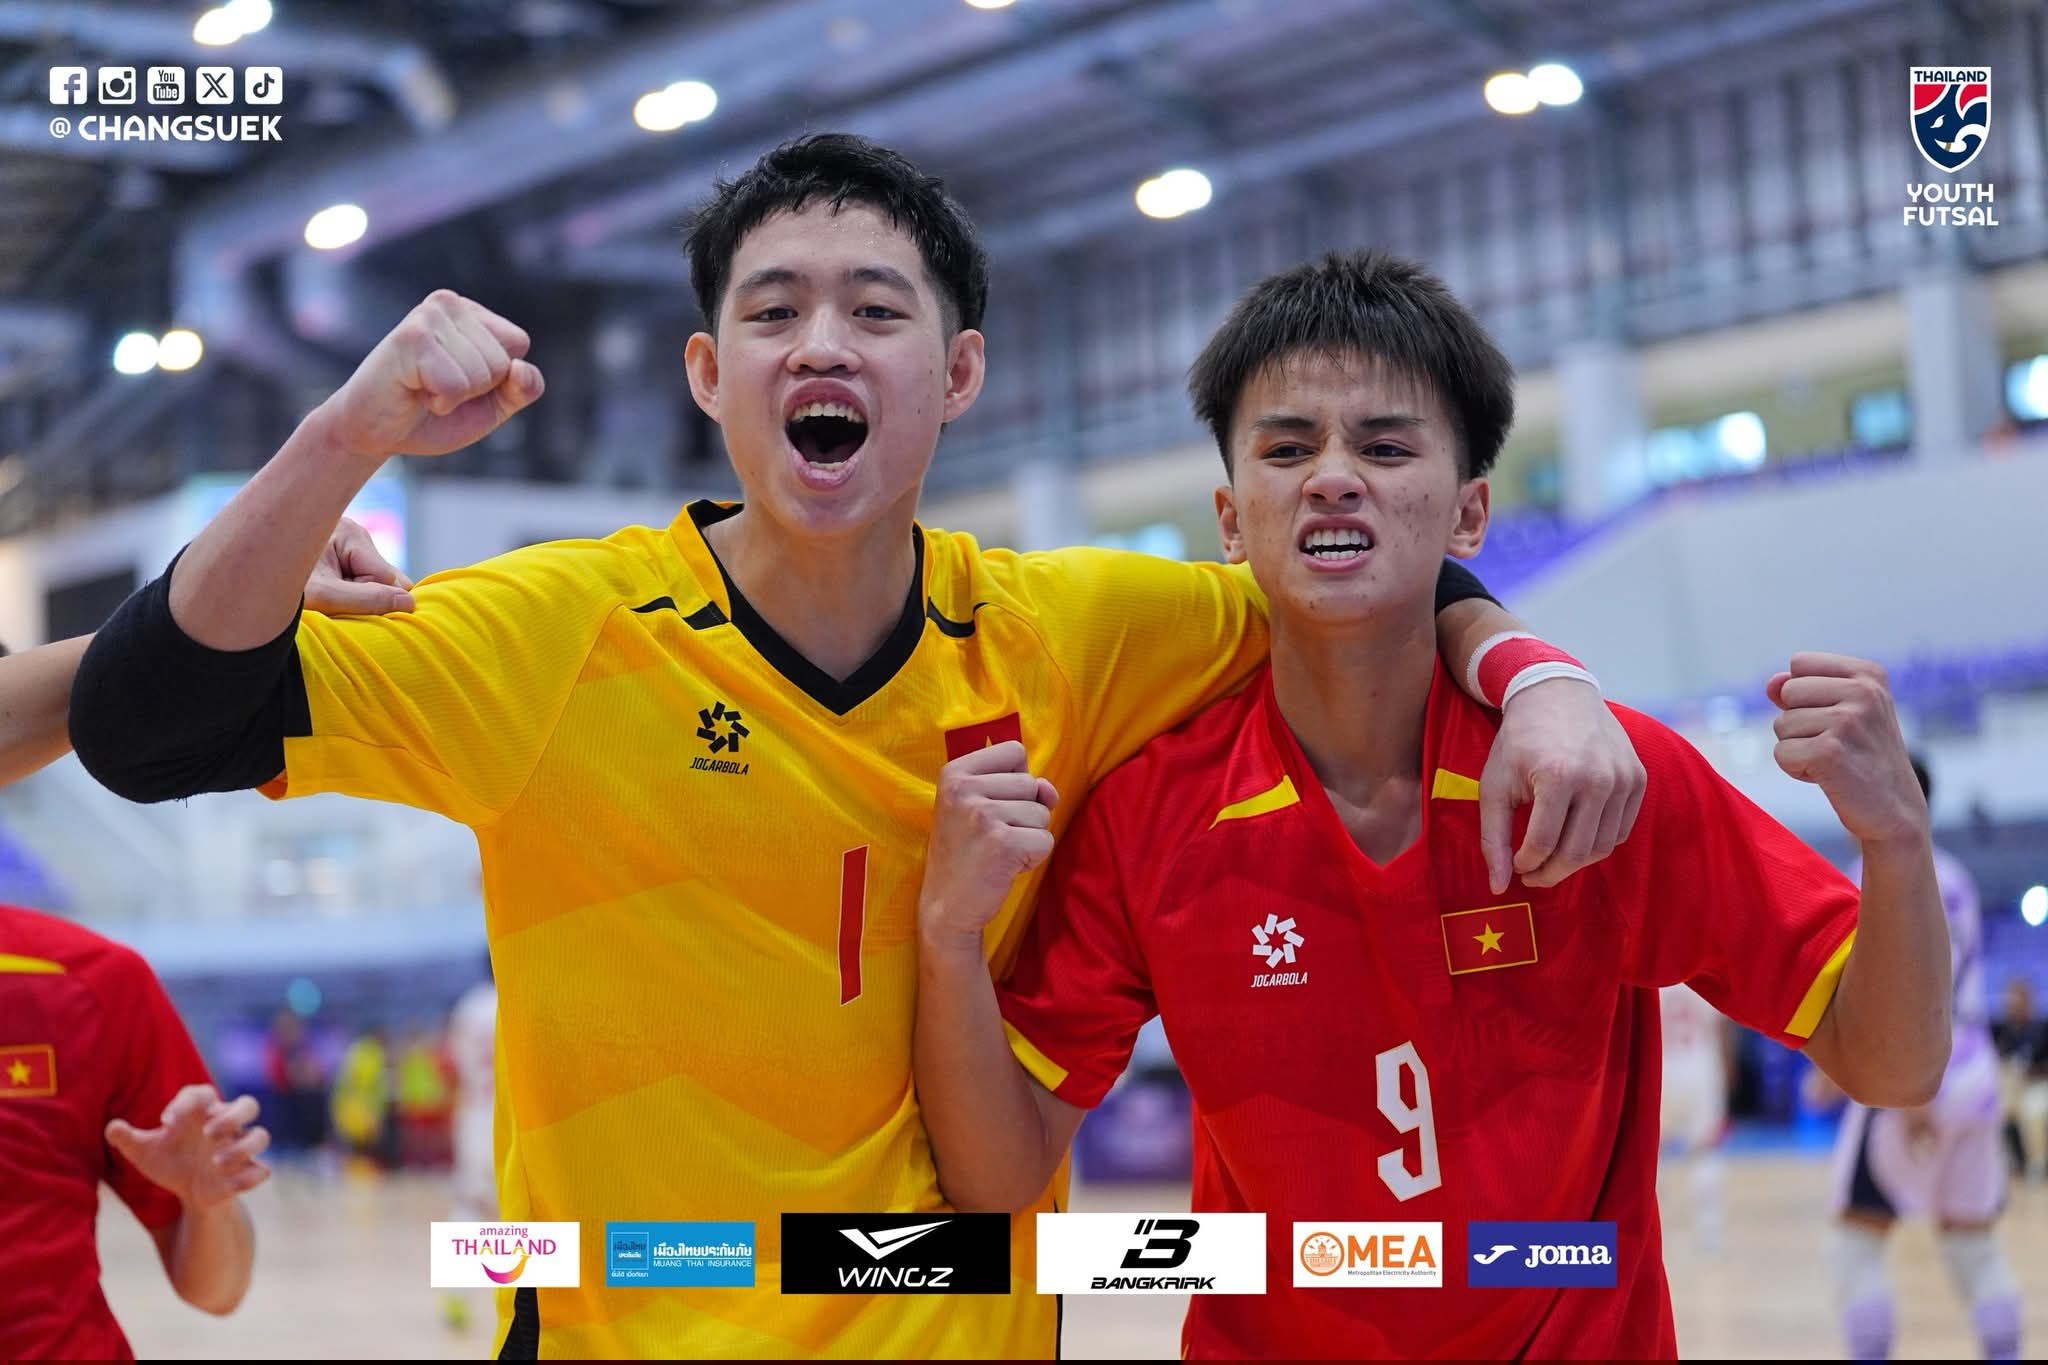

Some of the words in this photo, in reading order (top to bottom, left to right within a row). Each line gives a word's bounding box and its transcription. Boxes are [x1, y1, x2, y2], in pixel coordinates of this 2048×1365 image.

[689, 757, 749, 776] JOGARBOLA
[838, 844, 870, 1006] 1
[1251, 972, 1309, 988] JOGARBOLA
[1375, 1040, 1442, 1202] 9
